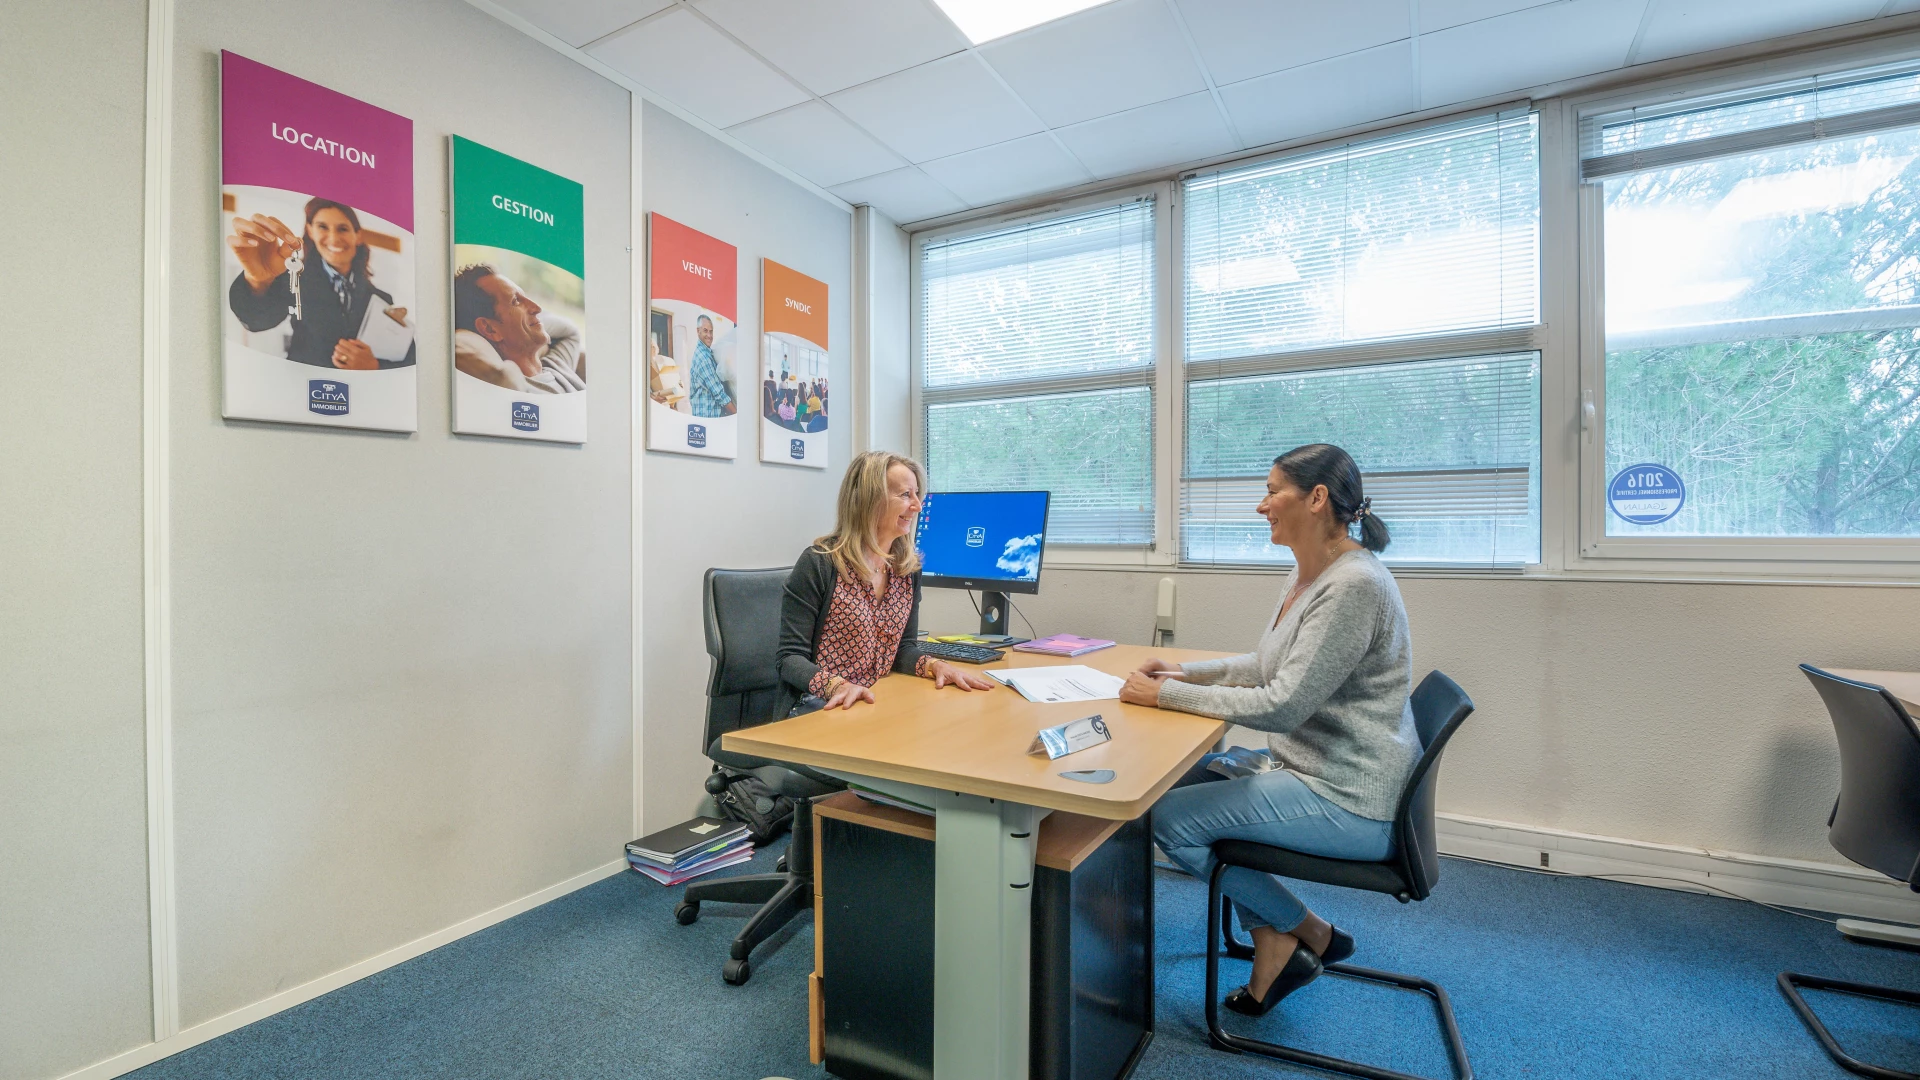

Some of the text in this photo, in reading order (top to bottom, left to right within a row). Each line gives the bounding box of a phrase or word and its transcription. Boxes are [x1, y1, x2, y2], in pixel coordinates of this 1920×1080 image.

[272, 122, 376, 169] LOCATION
[492, 195, 554, 227] GESTION
[682, 260, 712, 280] VENTE
[785, 297, 812, 315] SYNDIC
[311, 403, 347, 411] IMMOBILIER
